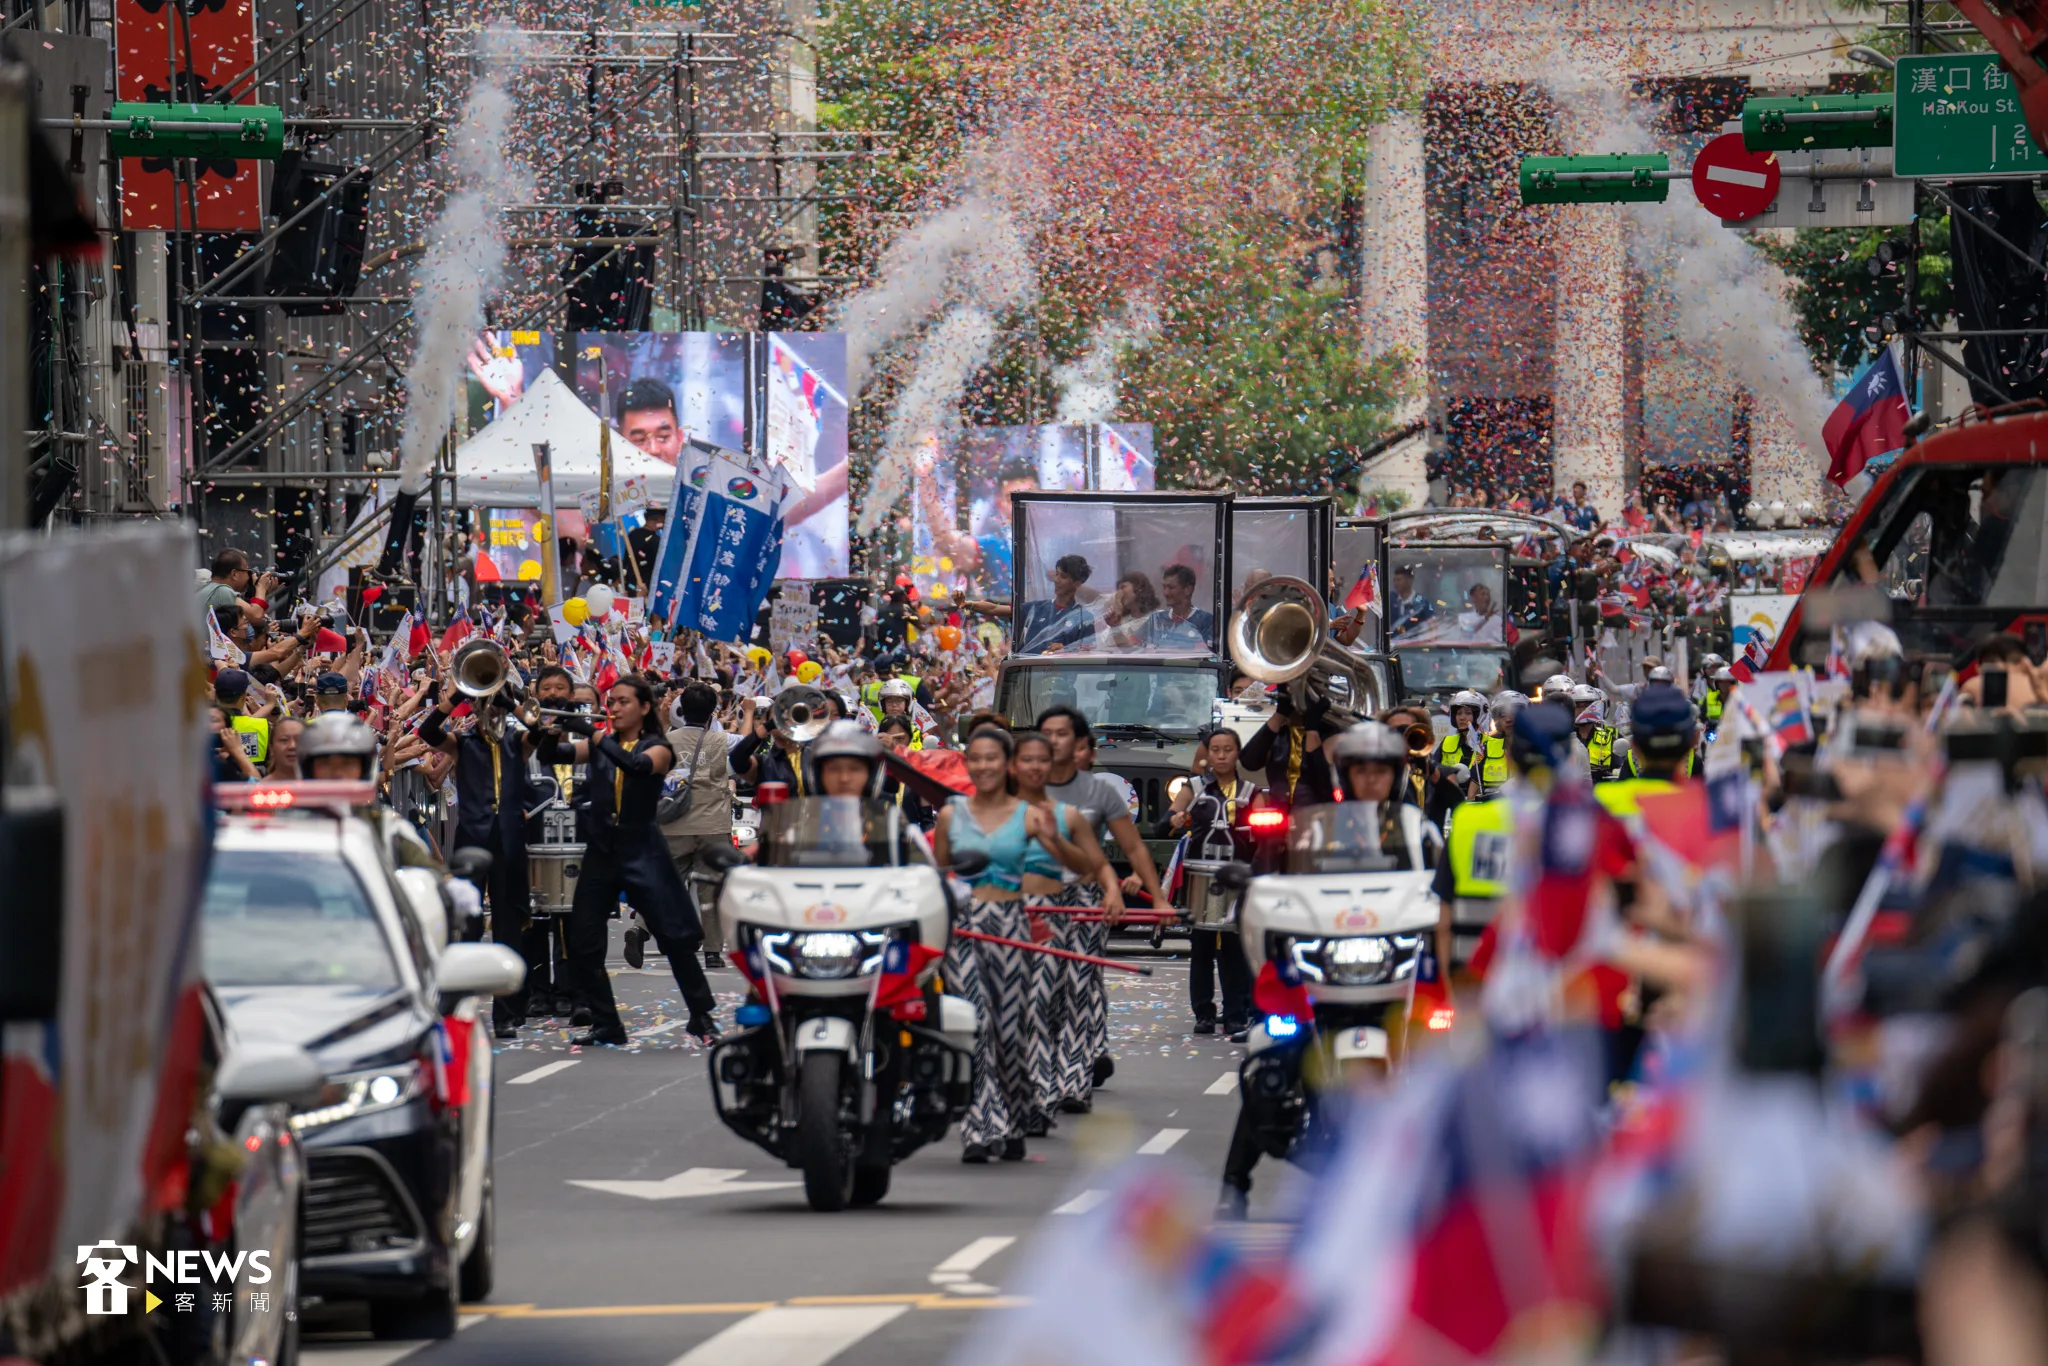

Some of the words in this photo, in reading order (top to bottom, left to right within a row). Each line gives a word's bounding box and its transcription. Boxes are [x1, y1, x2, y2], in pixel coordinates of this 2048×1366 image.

[1911, 64, 2009, 93] 漢口街
[1922, 100, 1989, 115] HanKou
[1995, 99, 2017, 113] St.
[2013, 123, 2026, 139] 2
